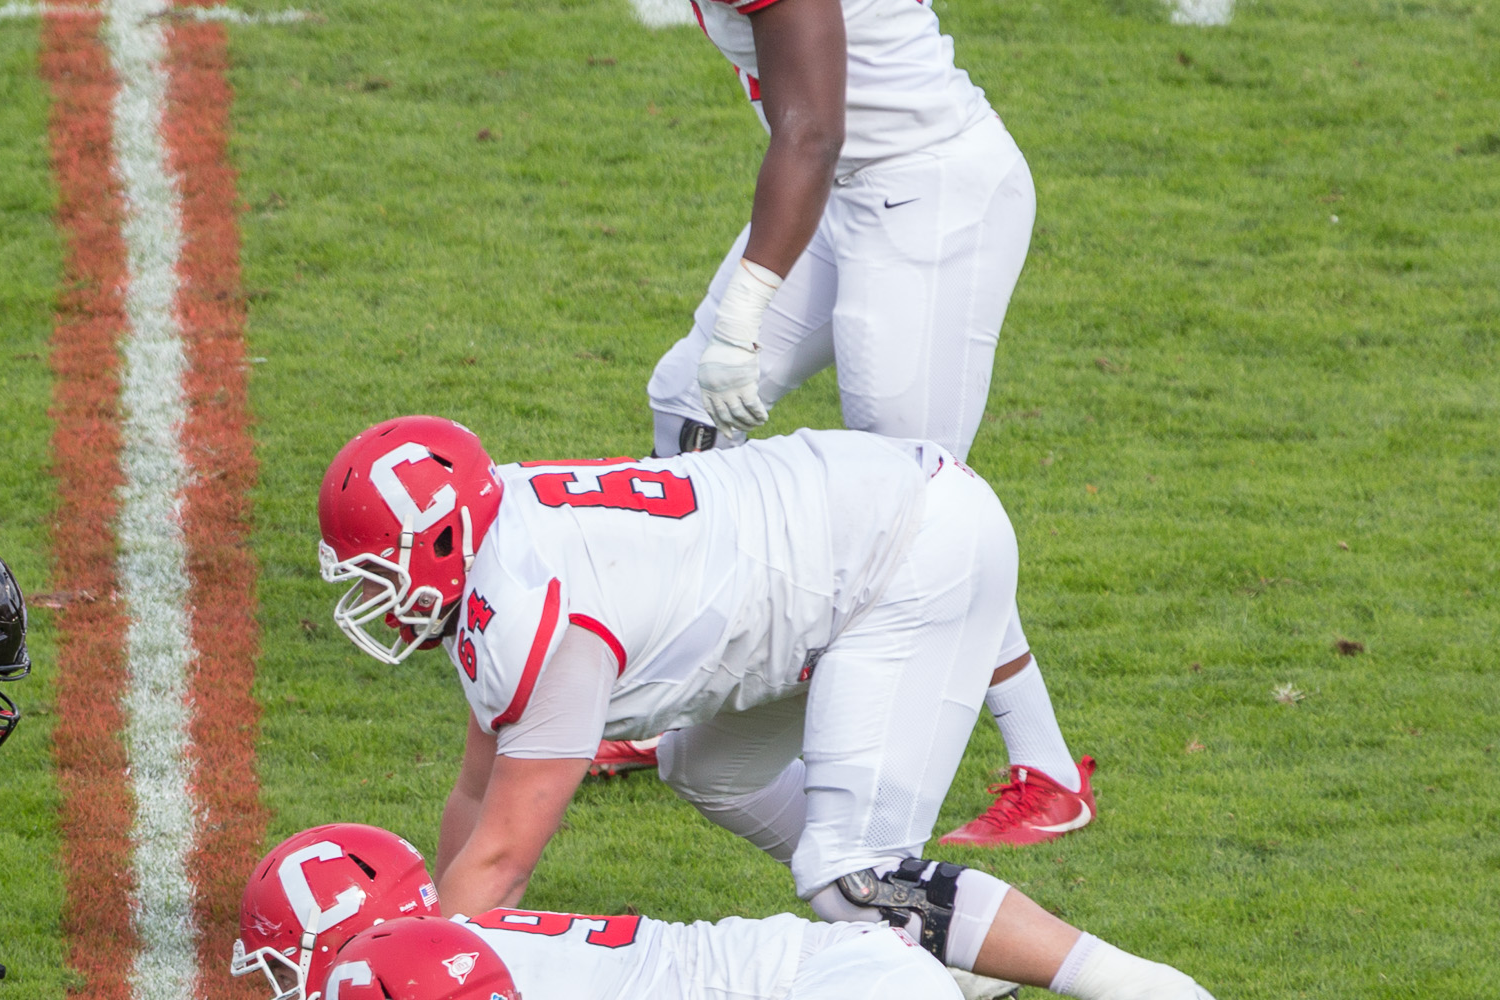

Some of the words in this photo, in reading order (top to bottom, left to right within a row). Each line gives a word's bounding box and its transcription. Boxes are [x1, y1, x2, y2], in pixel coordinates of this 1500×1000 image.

[369, 440, 457, 533] C
[457, 587, 497, 683] 64
[277, 841, 367, 935] C
